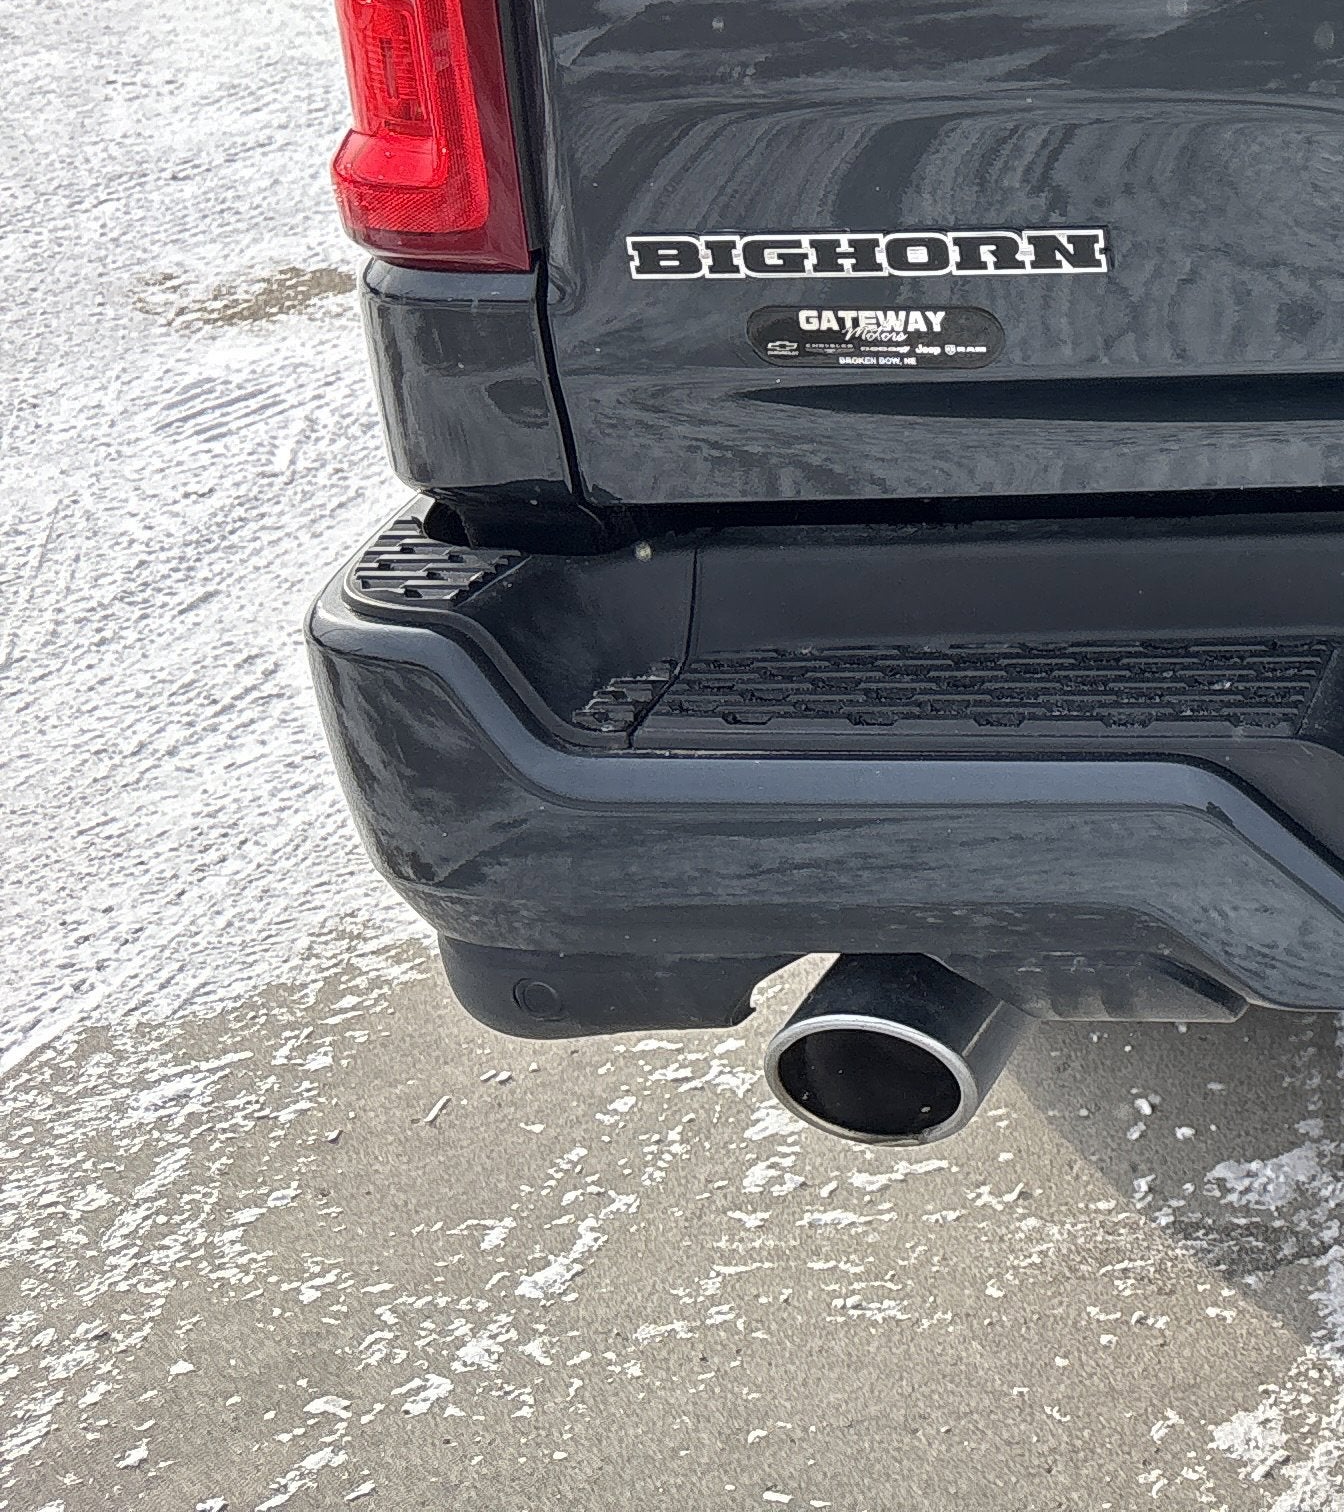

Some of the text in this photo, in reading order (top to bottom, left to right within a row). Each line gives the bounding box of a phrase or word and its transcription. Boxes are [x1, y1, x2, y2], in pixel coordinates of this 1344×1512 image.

[626, 229, 1108, 279] BIGHORN
[798, 309, 946, 332] GATEWAY
[842, 325, 909, 342] Motors
[915, 344, 941, 355] Jeep
[838, 356, 877, 365] BROKEN
